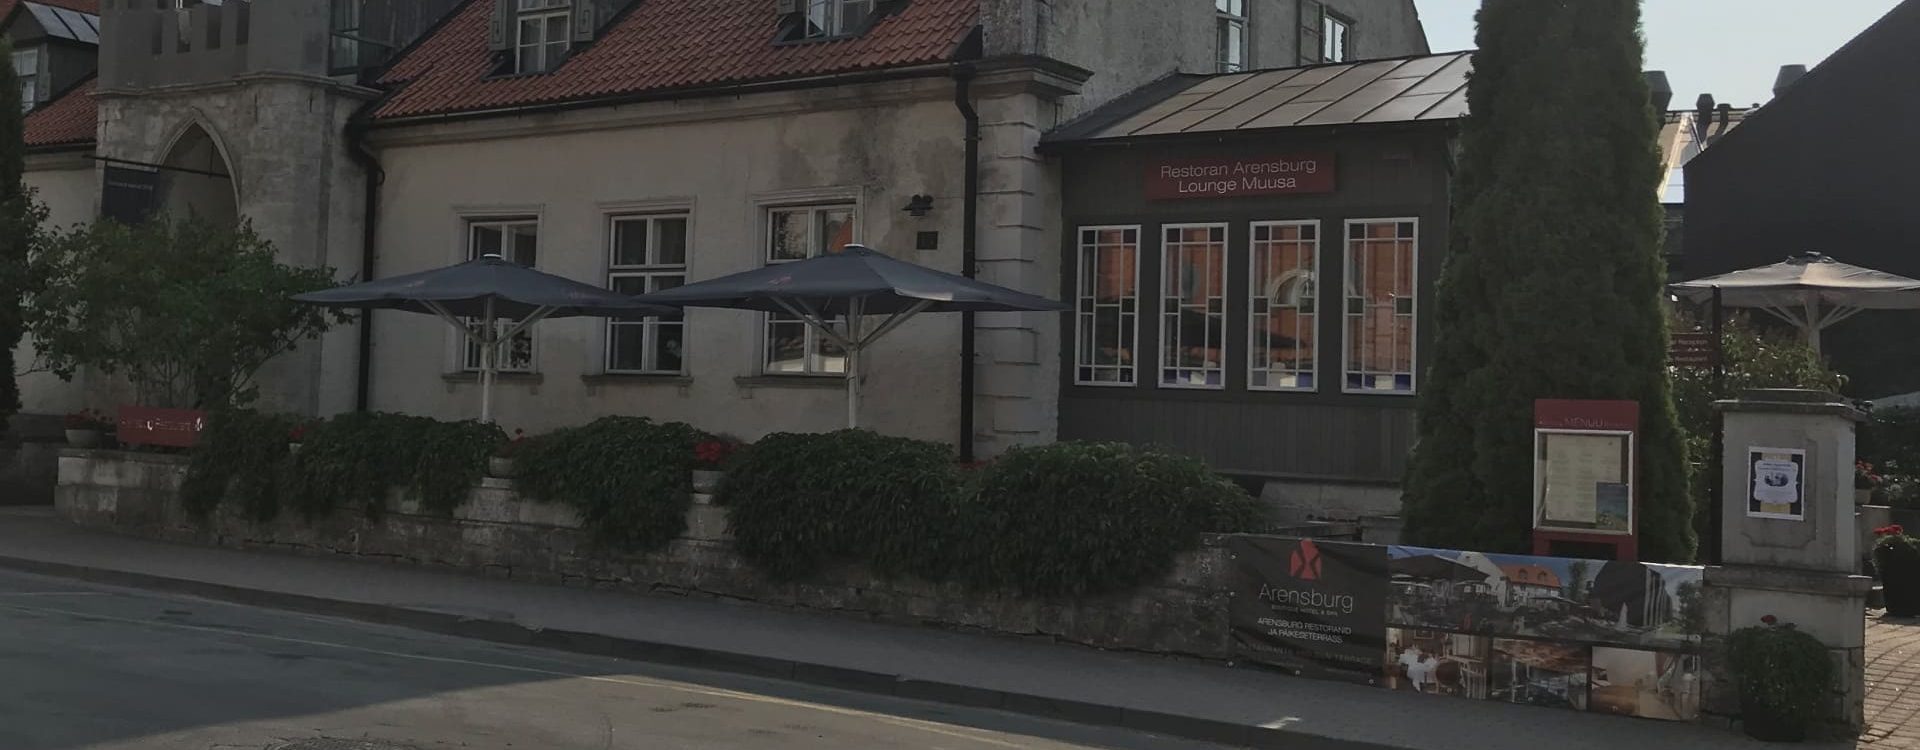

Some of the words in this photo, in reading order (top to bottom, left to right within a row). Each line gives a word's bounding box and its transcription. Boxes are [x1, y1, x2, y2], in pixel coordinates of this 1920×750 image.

[1160, 164, 1228, 179] Restoran
[1233, 159, 1317, 174] Arensburg
[1178, 179, 1237, 194] Lounge
[1242, 176, 1297, 192] Muusa
[1258, 583, 1354, 614] Arensburg
[1257, 617, 1304, 630] ARENSBURG
[1267, 628, 1278, 636] JA
